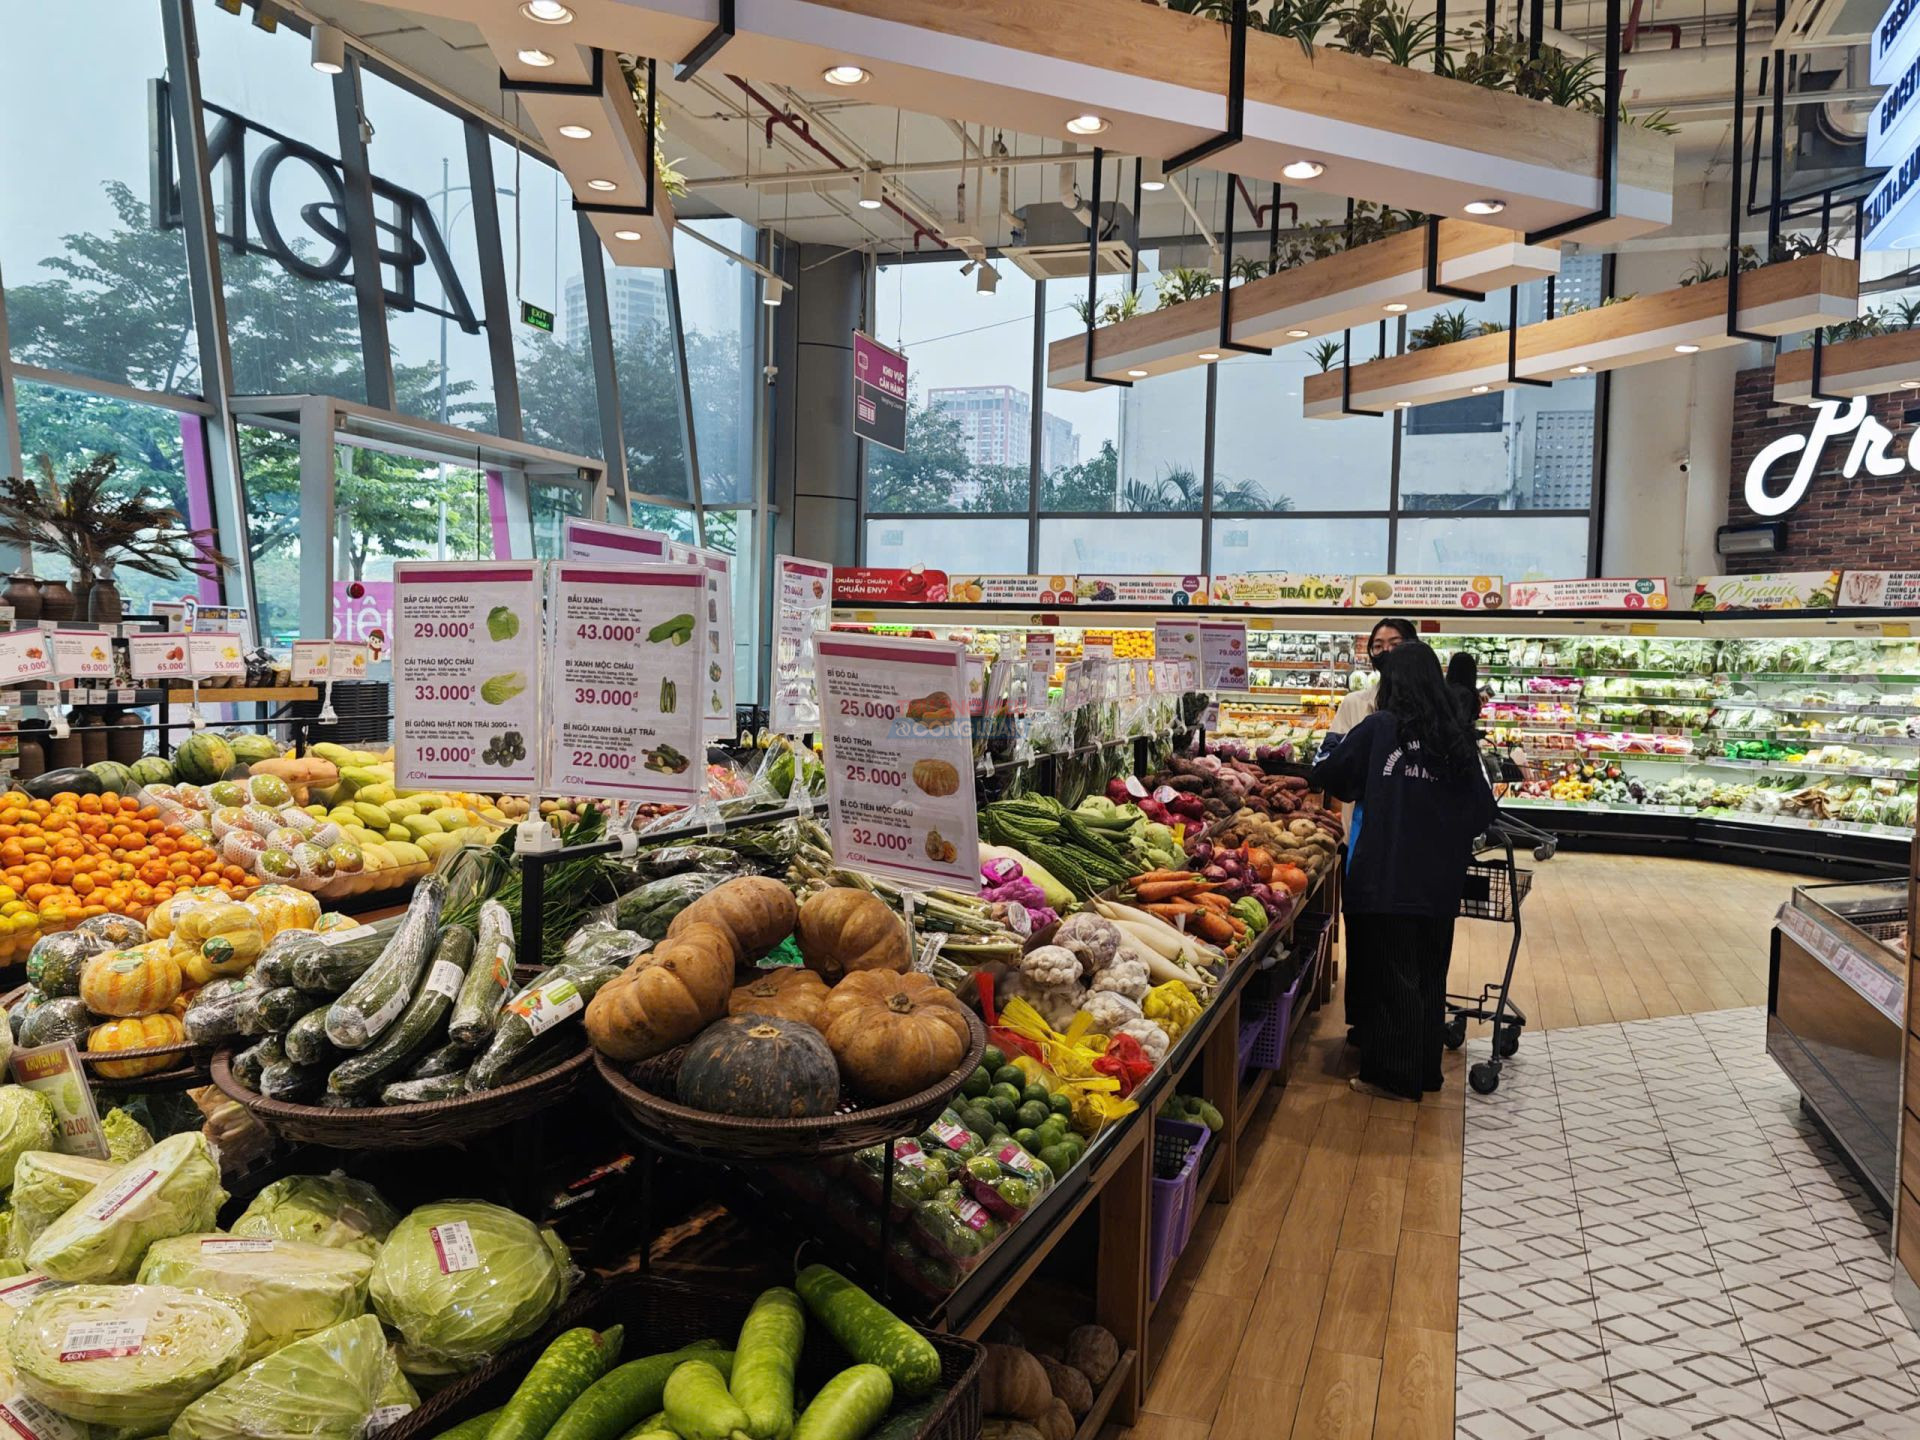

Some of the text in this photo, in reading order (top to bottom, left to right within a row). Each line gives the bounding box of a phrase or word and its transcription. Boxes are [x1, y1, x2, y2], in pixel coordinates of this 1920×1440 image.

[532, 308, 546, 320] EXIT
[1745, 395, 1920, 516] Pr
[838, 584, 865, 592] CHUẨN
[1280, 584, 1310, 598] TRÁI
[1314, 584, 1344, 599] CÂY
[1717, 580, 1799, 604] Organic
[432, 595, 448, 604] MỘC
[449, 595, 468, 603] CHÂU
[437, 657, 453, 666] MỘC
[455, 657, 475, 665] CHÂU
[595, 660, 611, 669] MỘC
[614, 662, 634, 670] CHÂU
